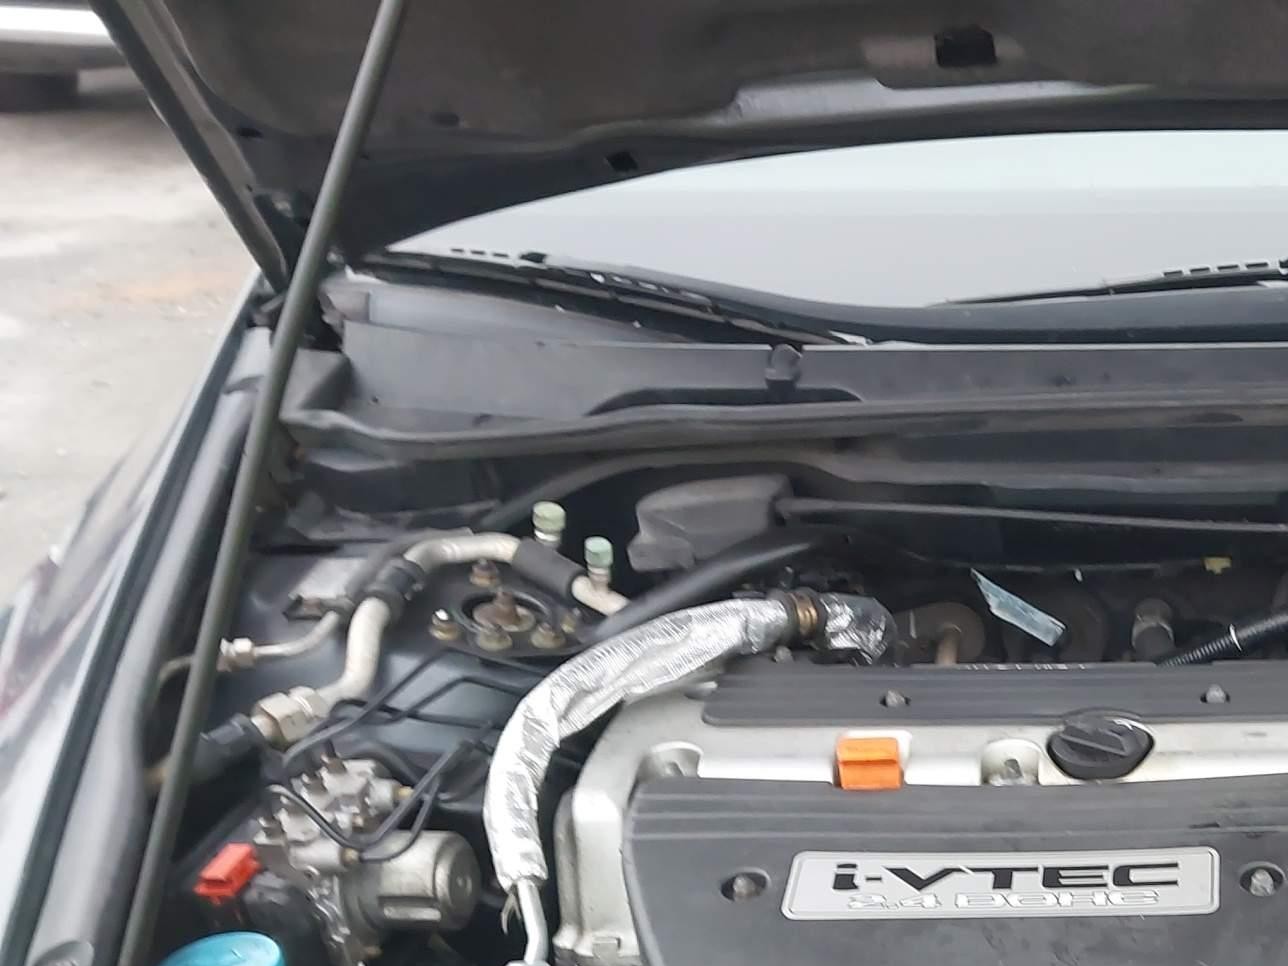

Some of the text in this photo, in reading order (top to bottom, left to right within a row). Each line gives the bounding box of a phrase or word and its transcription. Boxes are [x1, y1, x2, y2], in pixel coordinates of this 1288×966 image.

[832, 862, 1180, 891] i-VTEC
[847, 890, 1160, 910] 2.4 DOHC
